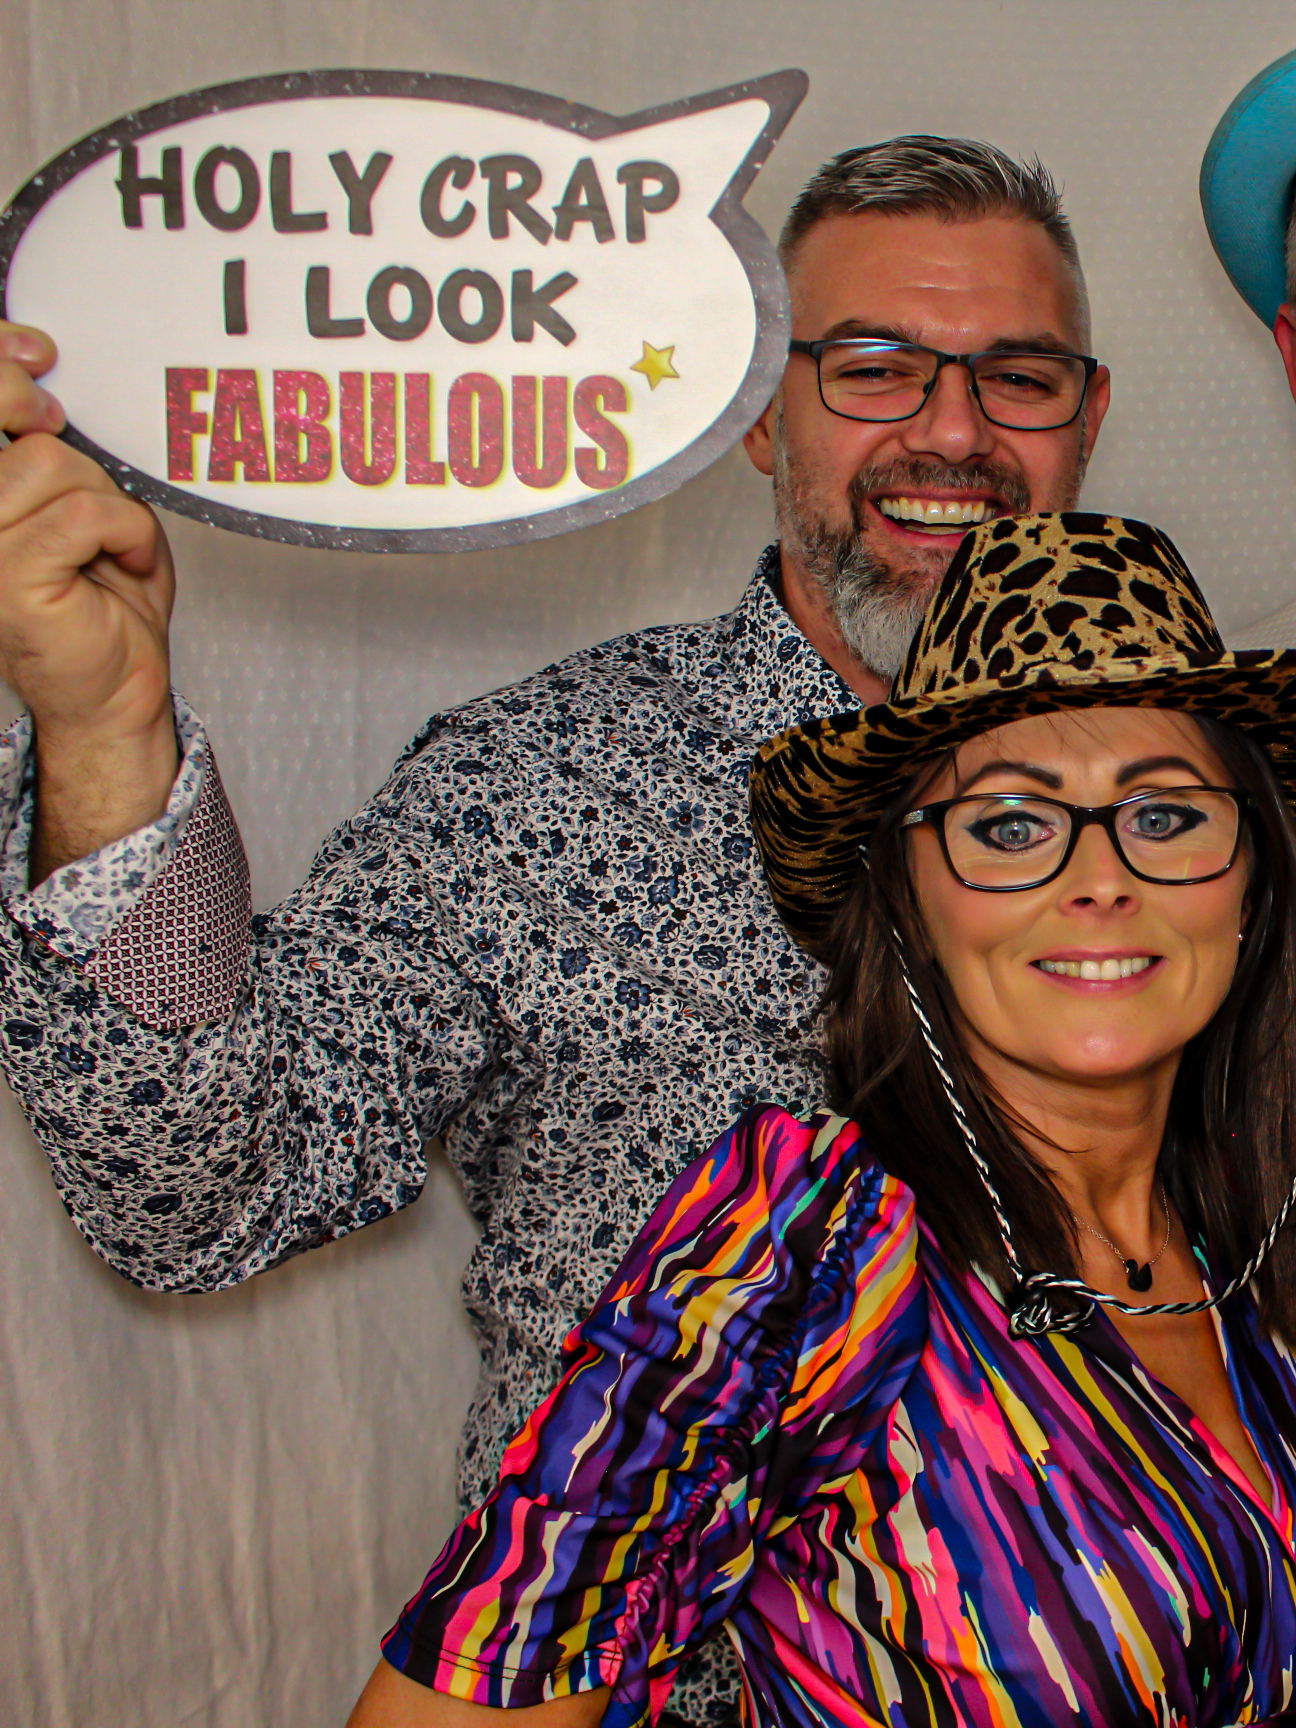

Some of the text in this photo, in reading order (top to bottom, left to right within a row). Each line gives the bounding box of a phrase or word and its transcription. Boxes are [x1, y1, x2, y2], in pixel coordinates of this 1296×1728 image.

[116, 145, 681, 245] HOLY CRAP
[222, 258, 579, 346] I LOOK
[164, 365, 633, 490] FABULOUS
